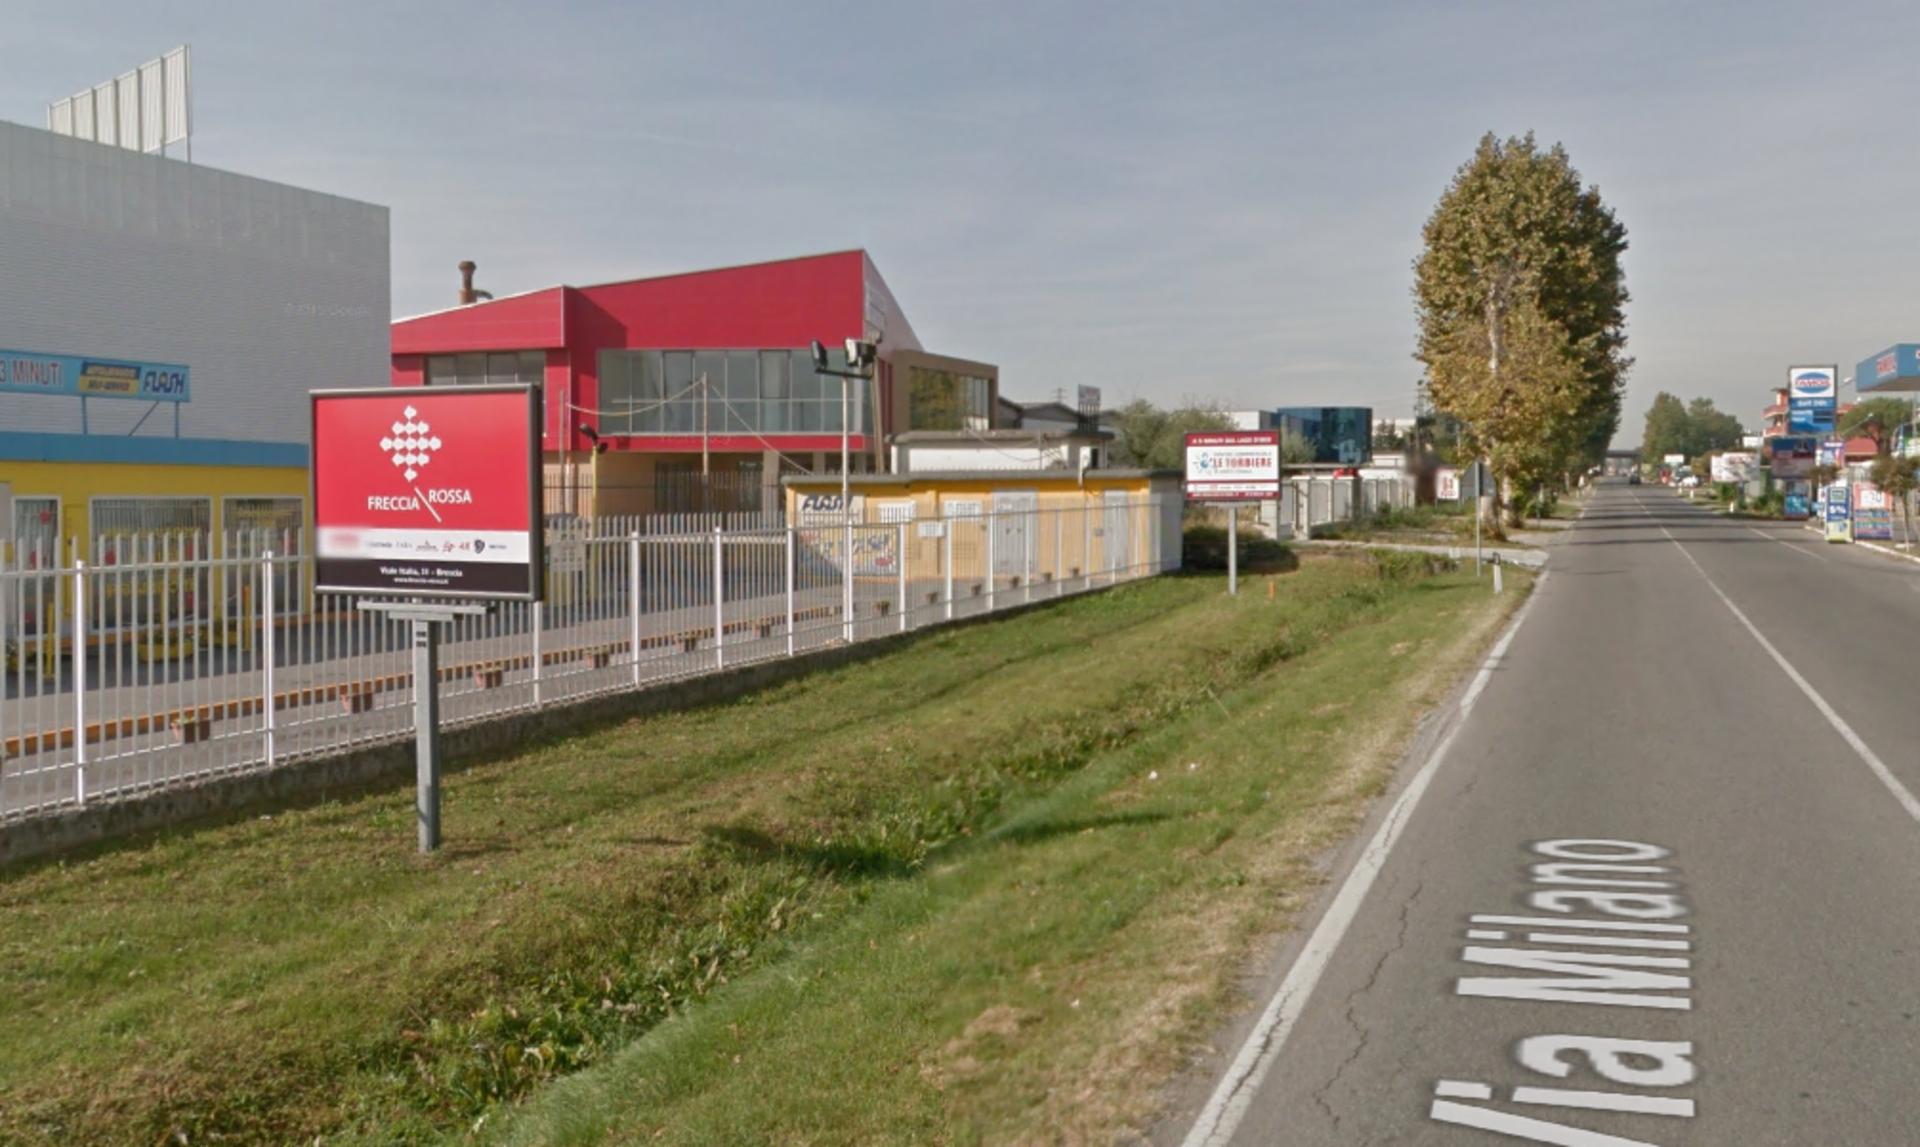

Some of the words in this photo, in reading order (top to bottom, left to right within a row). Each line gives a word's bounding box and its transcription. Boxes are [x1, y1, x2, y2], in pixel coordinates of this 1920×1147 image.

[12, 360, 64, 387] MINUTI
[143, 371, 186, 395] FLASH
[1225, 457, 1272, 468] TORBIERE
[368, 496, 420, 511] FRECCIA
[428, 489, 472, 504] ROSSA
[436, 568, 464, 577] Brescia
